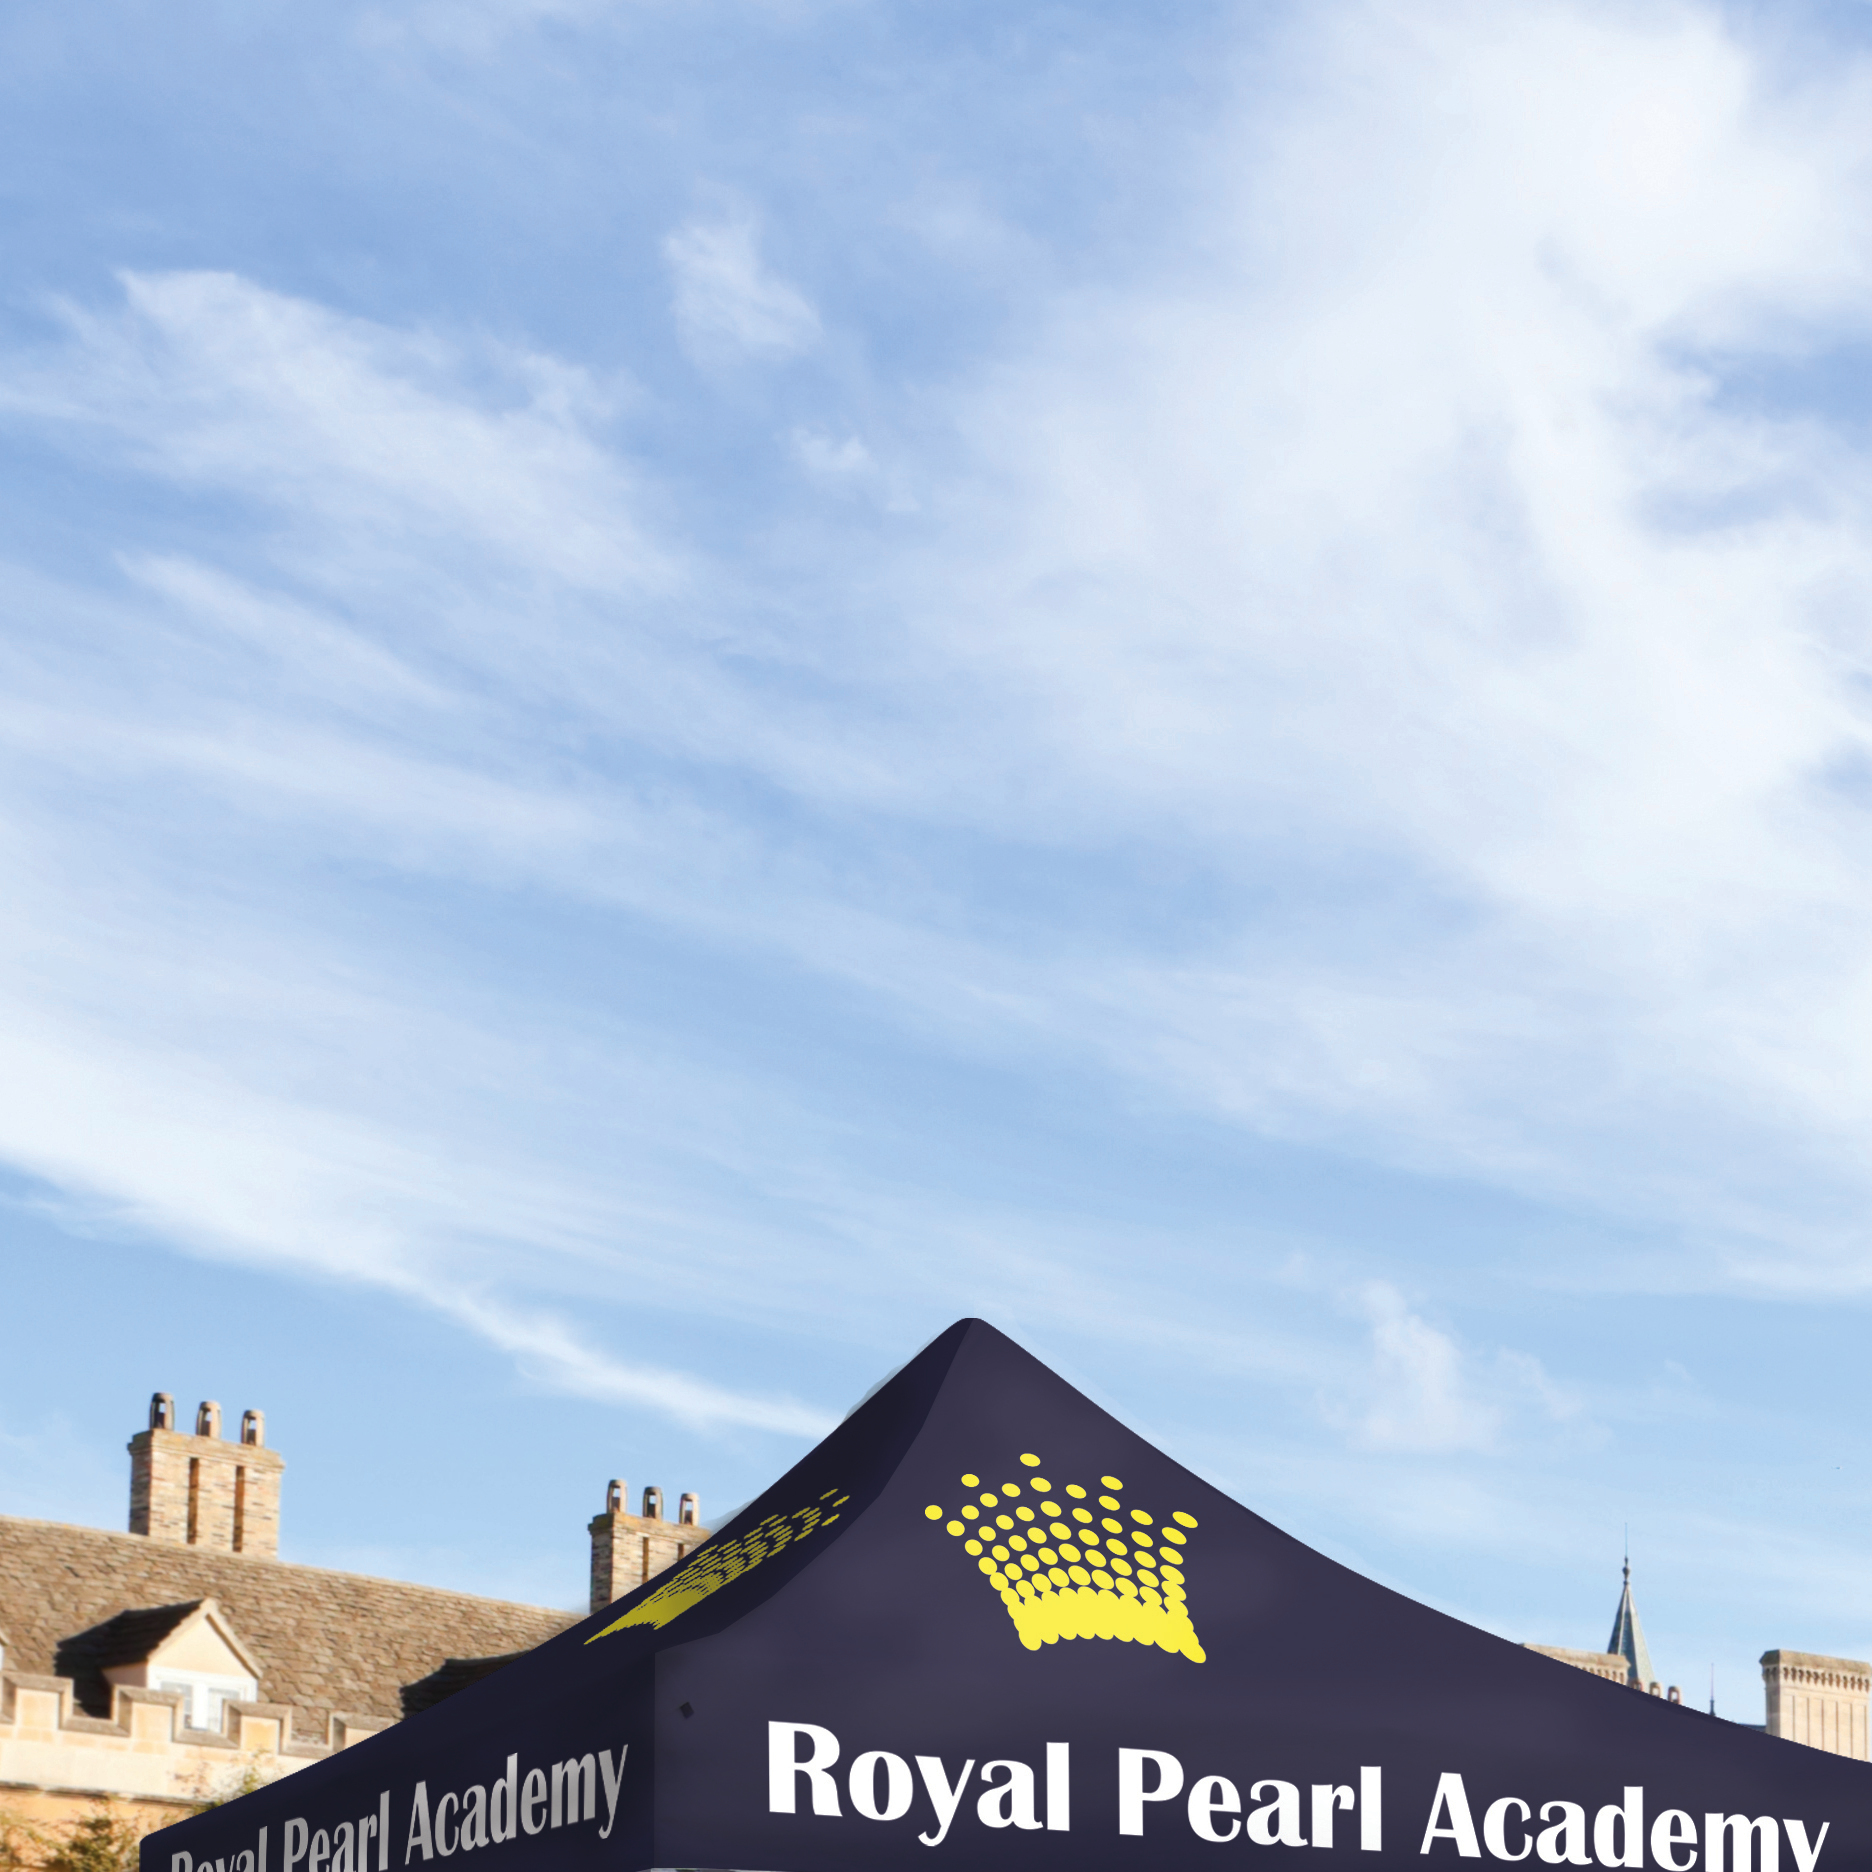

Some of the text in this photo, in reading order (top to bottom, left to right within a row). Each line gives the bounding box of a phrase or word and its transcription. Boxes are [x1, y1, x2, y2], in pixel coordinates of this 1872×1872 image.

[404, 1743, 629, 1867] Academy
[768, 1720, 1070, 1847] Royal
[1118, 1747, 1382, 1852] Pearl
